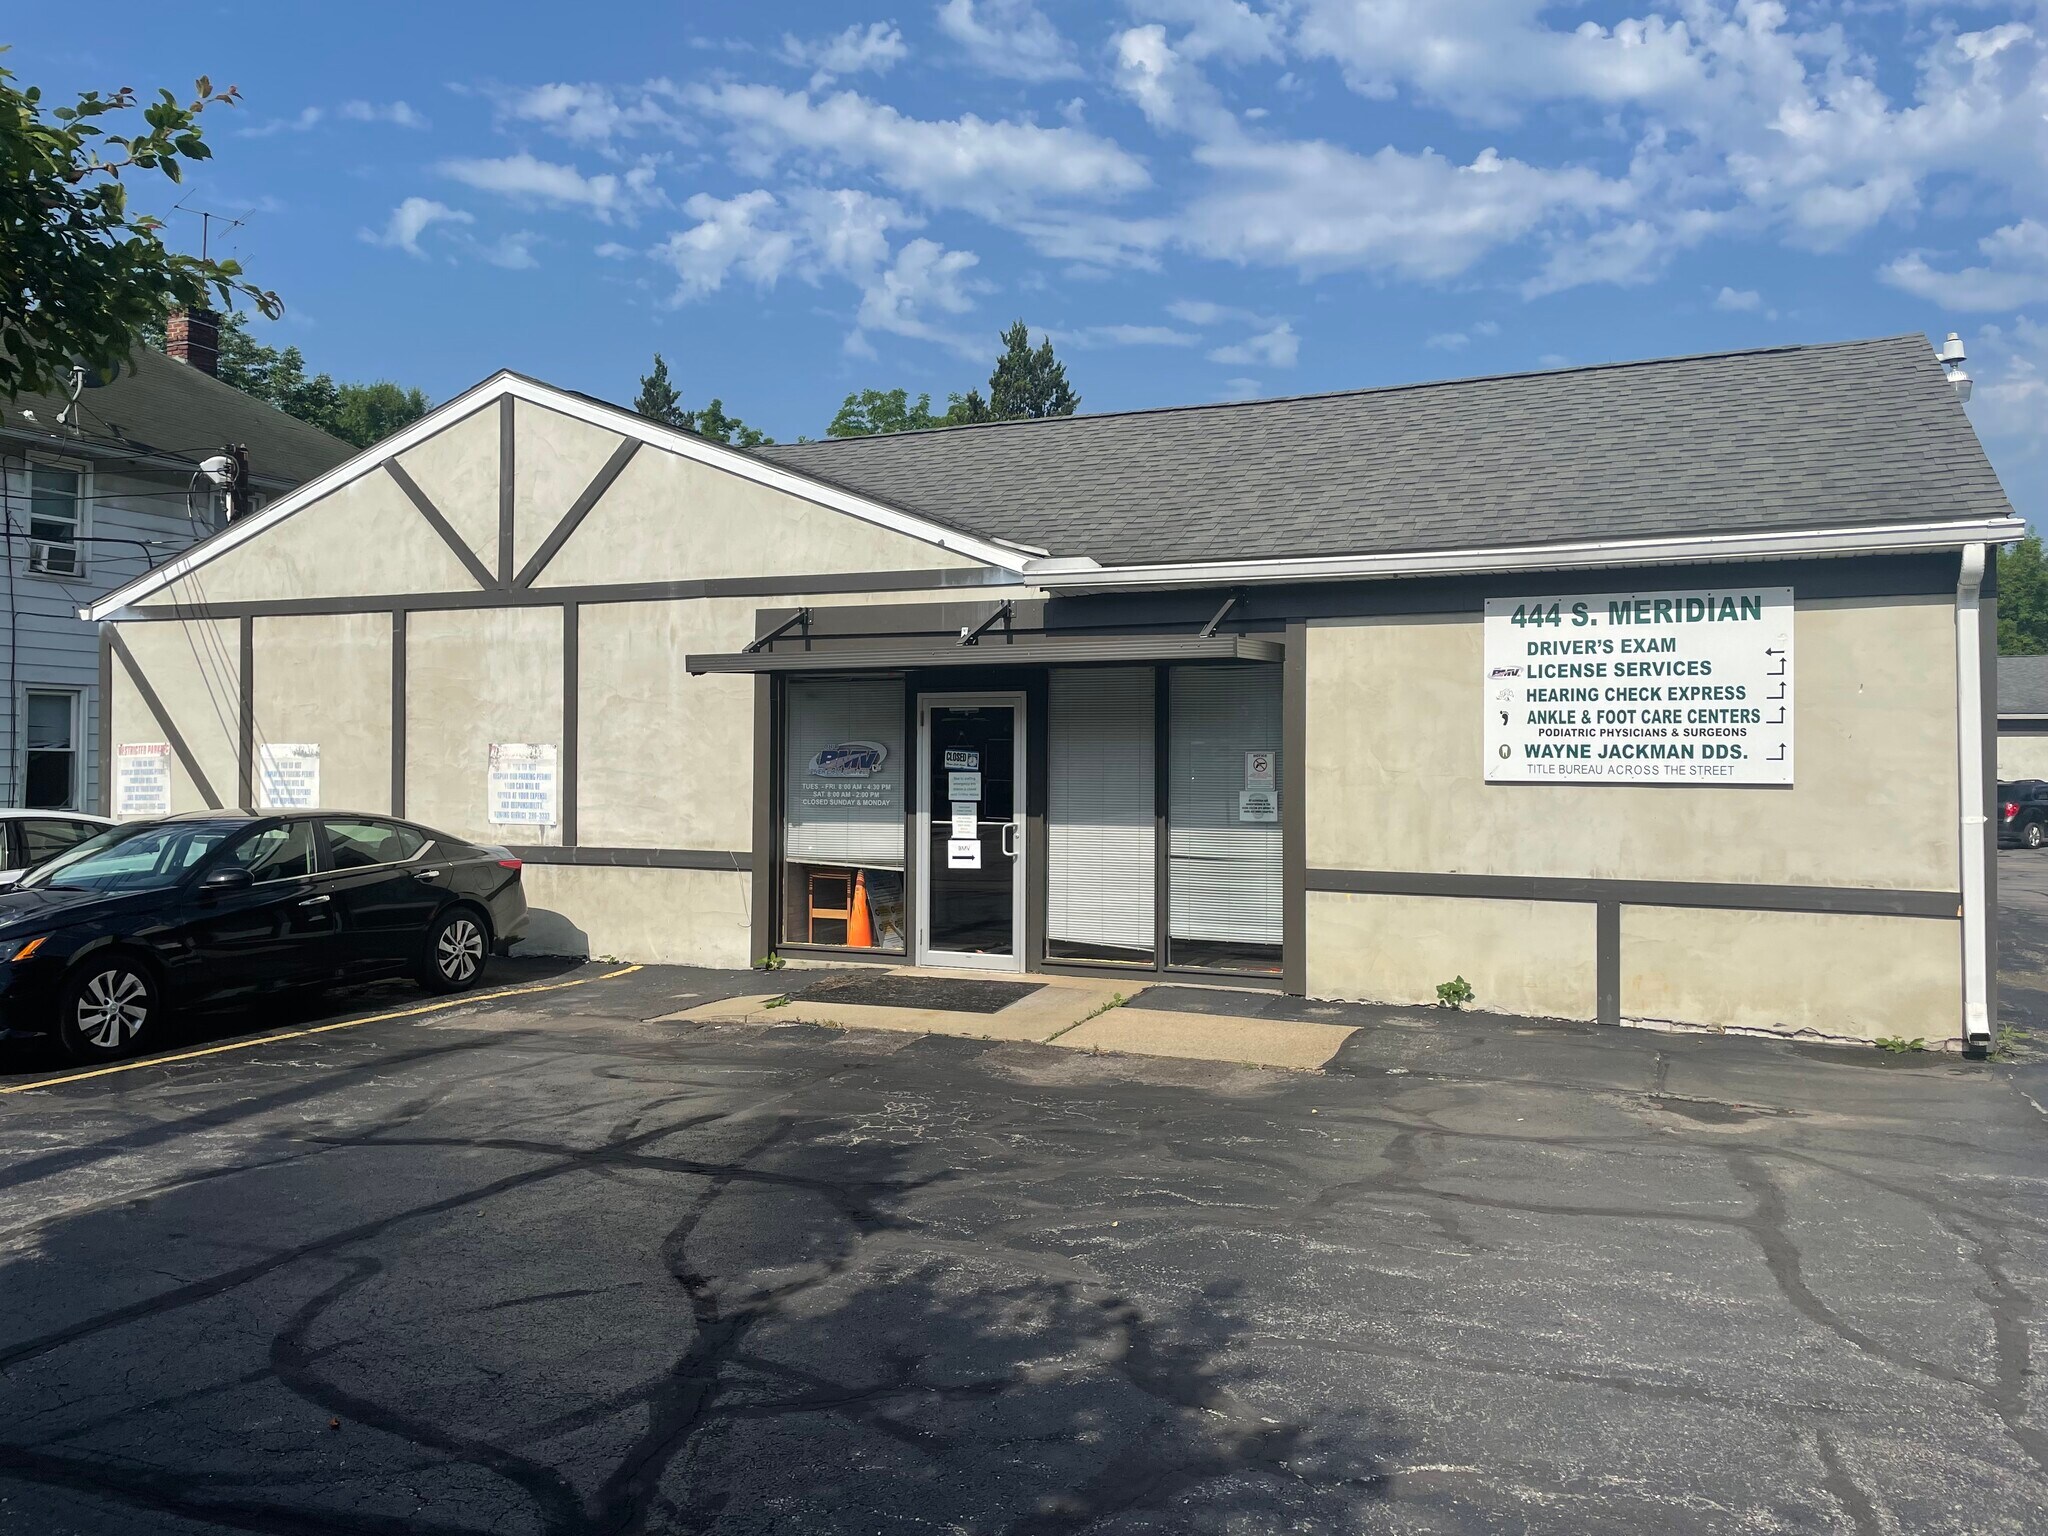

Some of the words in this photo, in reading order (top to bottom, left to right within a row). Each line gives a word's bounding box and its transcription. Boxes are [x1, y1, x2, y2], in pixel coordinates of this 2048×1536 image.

[1511, 603, 1562, 628] 444
[1571, 602, 1598, 627] S.
[1609, 596, 1761, 625] MERIDIAN
[1527, 639, 1614, 656] DRIVER'S
[1621, 638, 1676, 653] EXAM
[1527, 663, 1607, 678] LICENSE
[1614, 660, 1712, 677] SERVICES
[1526, 688, 1599, 702] HEARING
[1605, 687, 1662, 701] CHECK
[1668, 685, 1746, 700] EXPRESS
[1527, 710, 1576, 724] ANKLE
[1581, 709, 1591, 724] &
[1597, 709, 1636, 724] FOOT
[1641, 709, 1682, 724] CARE
[1687, 708, 1760, 723] CENTERS
[1538, 728, 1596, 737] PODIATRIC
[1600, 728, 1667, 737] PHYSICIANS
[1671, 728, 1679, 737] &
[1683, 728, 1747, 737] SURGEONS
[946, 751, 967, 762] CLOSED
[1524, 744, 1591, 759] WAYNE
[1597, 744, 1694, 759] JACKMAN
[1702, 744, 1748, 759] DDS.
[1527, 764, 1556, 774] TITLE
[1559, 764, 1603, 775] BUREAU
[1607, 765, 1659, 775] ACROSS
[1664, 765, 1686, 775] THE
[1689, 765, 1734, 776] STREET
